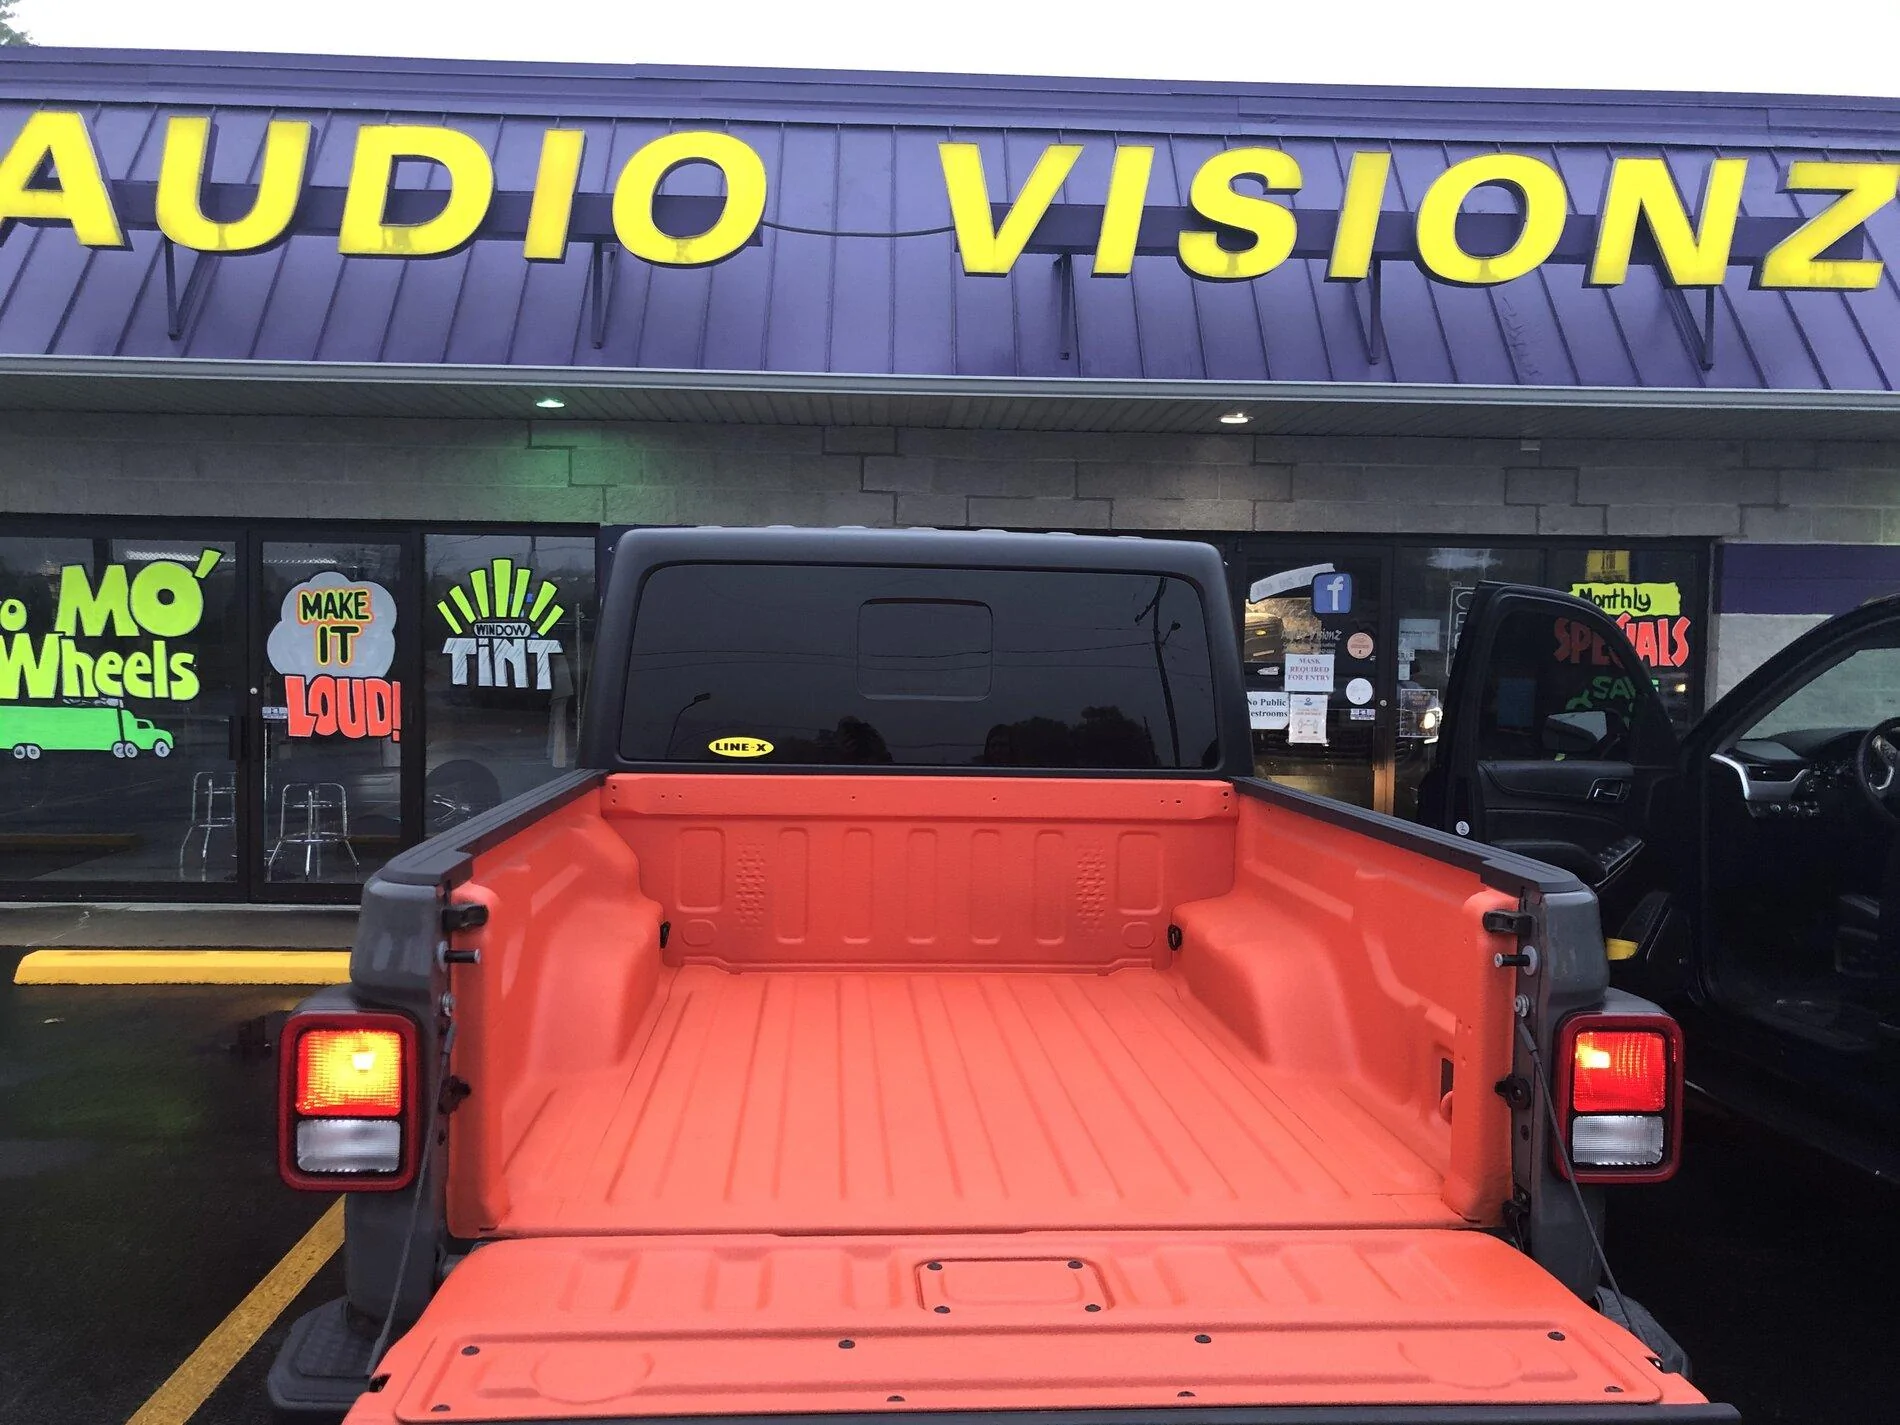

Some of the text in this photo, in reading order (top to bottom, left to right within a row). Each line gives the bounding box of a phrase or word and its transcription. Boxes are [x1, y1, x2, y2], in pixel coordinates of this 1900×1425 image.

[0, 111, 1900, 289] AUDIO VISIONZ
[300, 590, 371, 621] MAKE
[1579, 587, 1651, 612] Monthly
[318, 625, 361, 664] IT
[475, 624, 528, 637] WINDOW
[0, 632, 200, 700] Wheels
[285, 675, 401, 743] LOUD!
[1251, 709, 1288, 717] estrooms
[1260, 698, 1286, 706] Public
[715, 742, 767, 752] LINE-X
